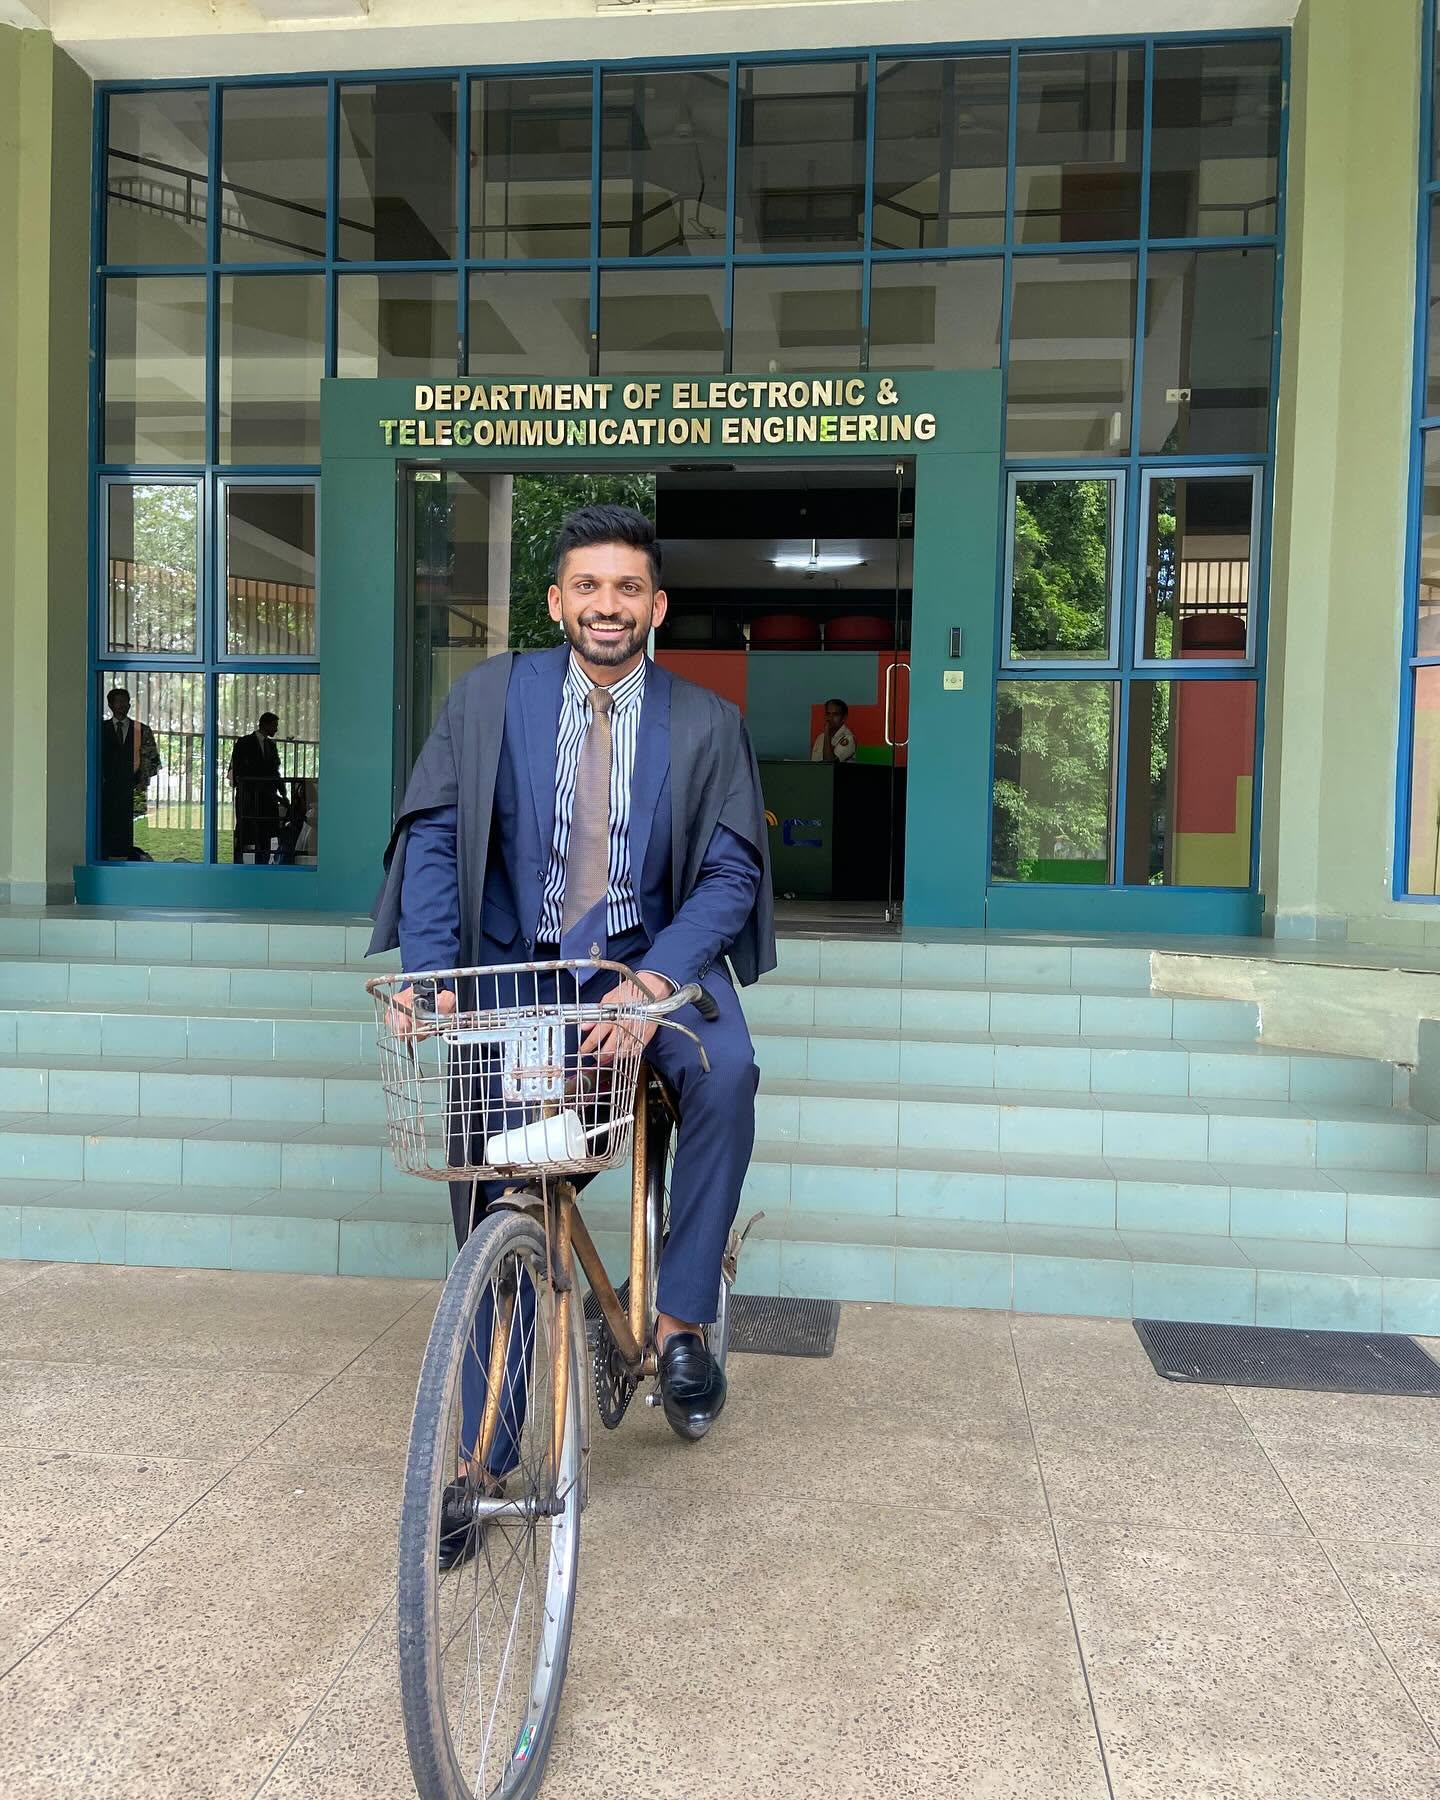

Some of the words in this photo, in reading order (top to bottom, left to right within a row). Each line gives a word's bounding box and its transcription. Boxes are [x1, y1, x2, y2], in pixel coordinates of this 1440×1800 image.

[415, 383, 613, 411] DEPARTMENT
[623, 383, 661, 410] OF
[672, 378, 865, 409] ELECTRONIC
[876, 378, 899, 405] &
[379, 417, 711, 446] TELECOMMUNICATION
[721, 413, 936, 444] ENGINEERING
